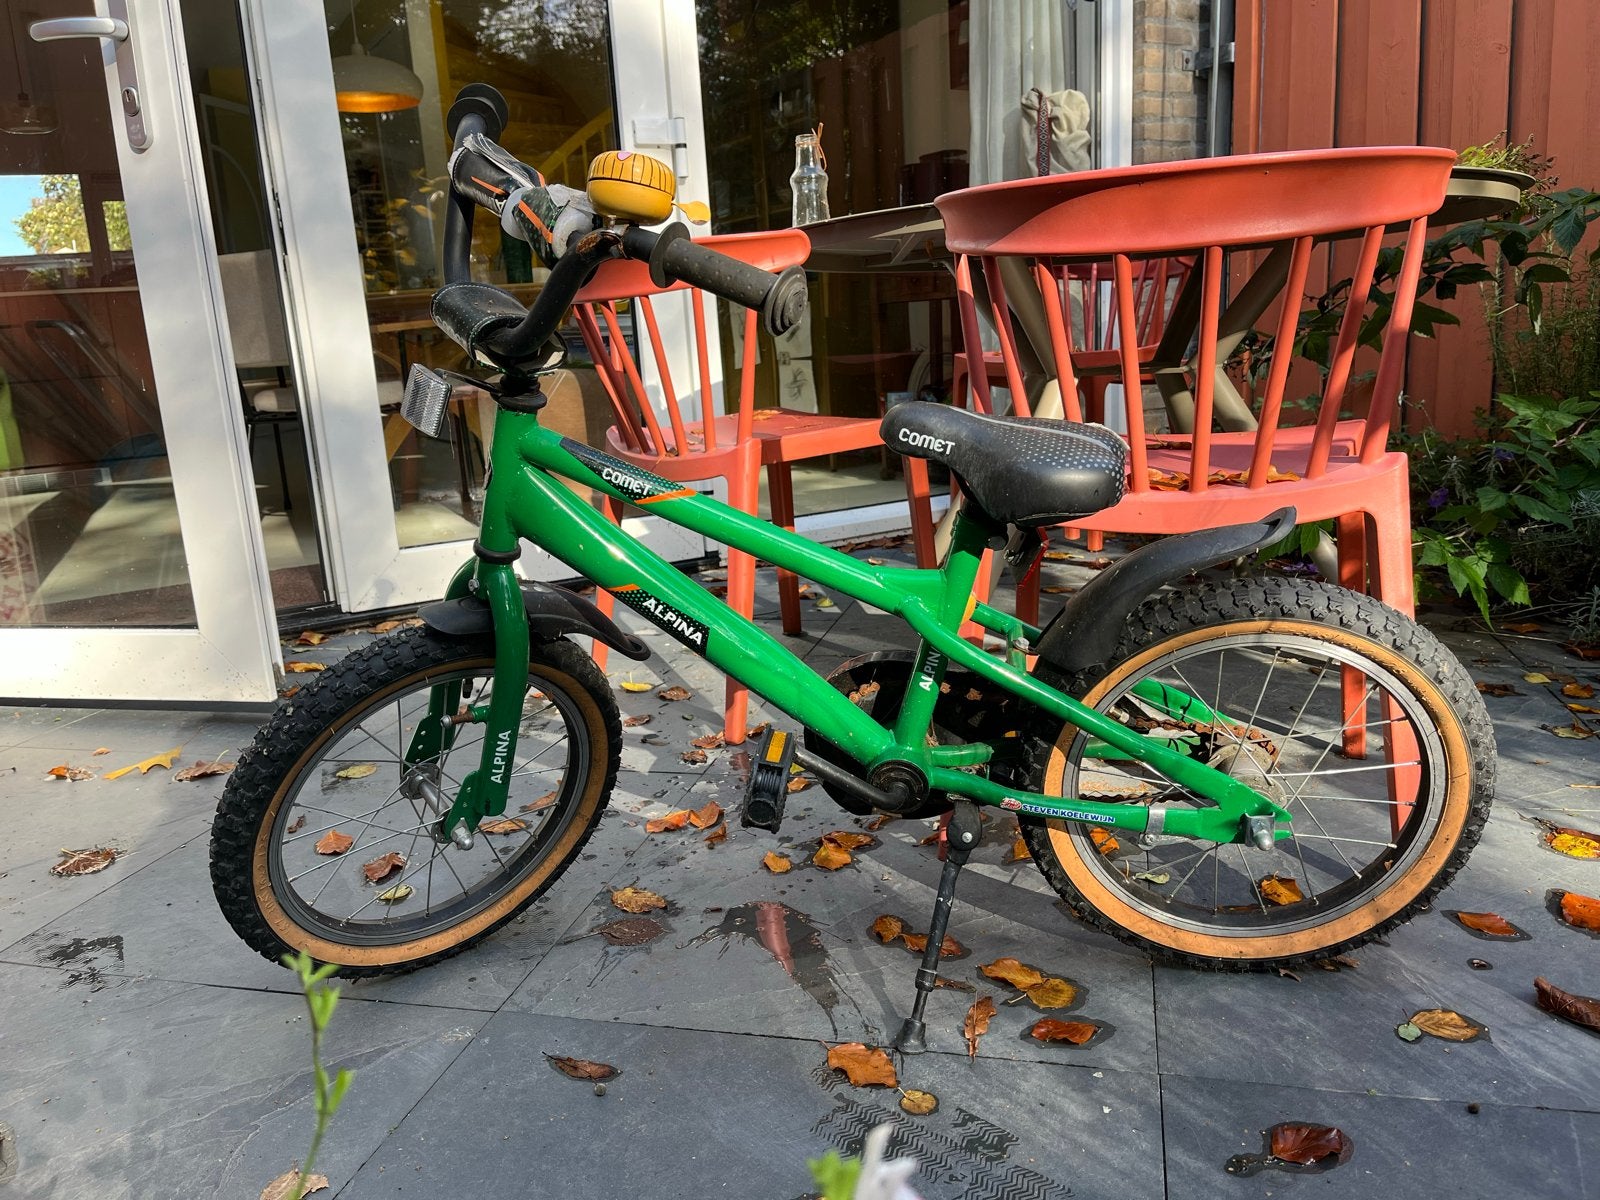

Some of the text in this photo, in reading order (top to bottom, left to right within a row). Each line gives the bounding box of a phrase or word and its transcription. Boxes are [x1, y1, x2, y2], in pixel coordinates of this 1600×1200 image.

[899, 428, 955, 455] COMET
[602, 467, 653, 496] COMET
[642, 596, 703, 645] ALPINA
[918, 646, 941, 691] ALPIN
[490, 730, 511, 784] ALPINA
[1022, 803, 1060, 816] STEVEN
[1060, 809, 1115, 823] KOELEWIJN
